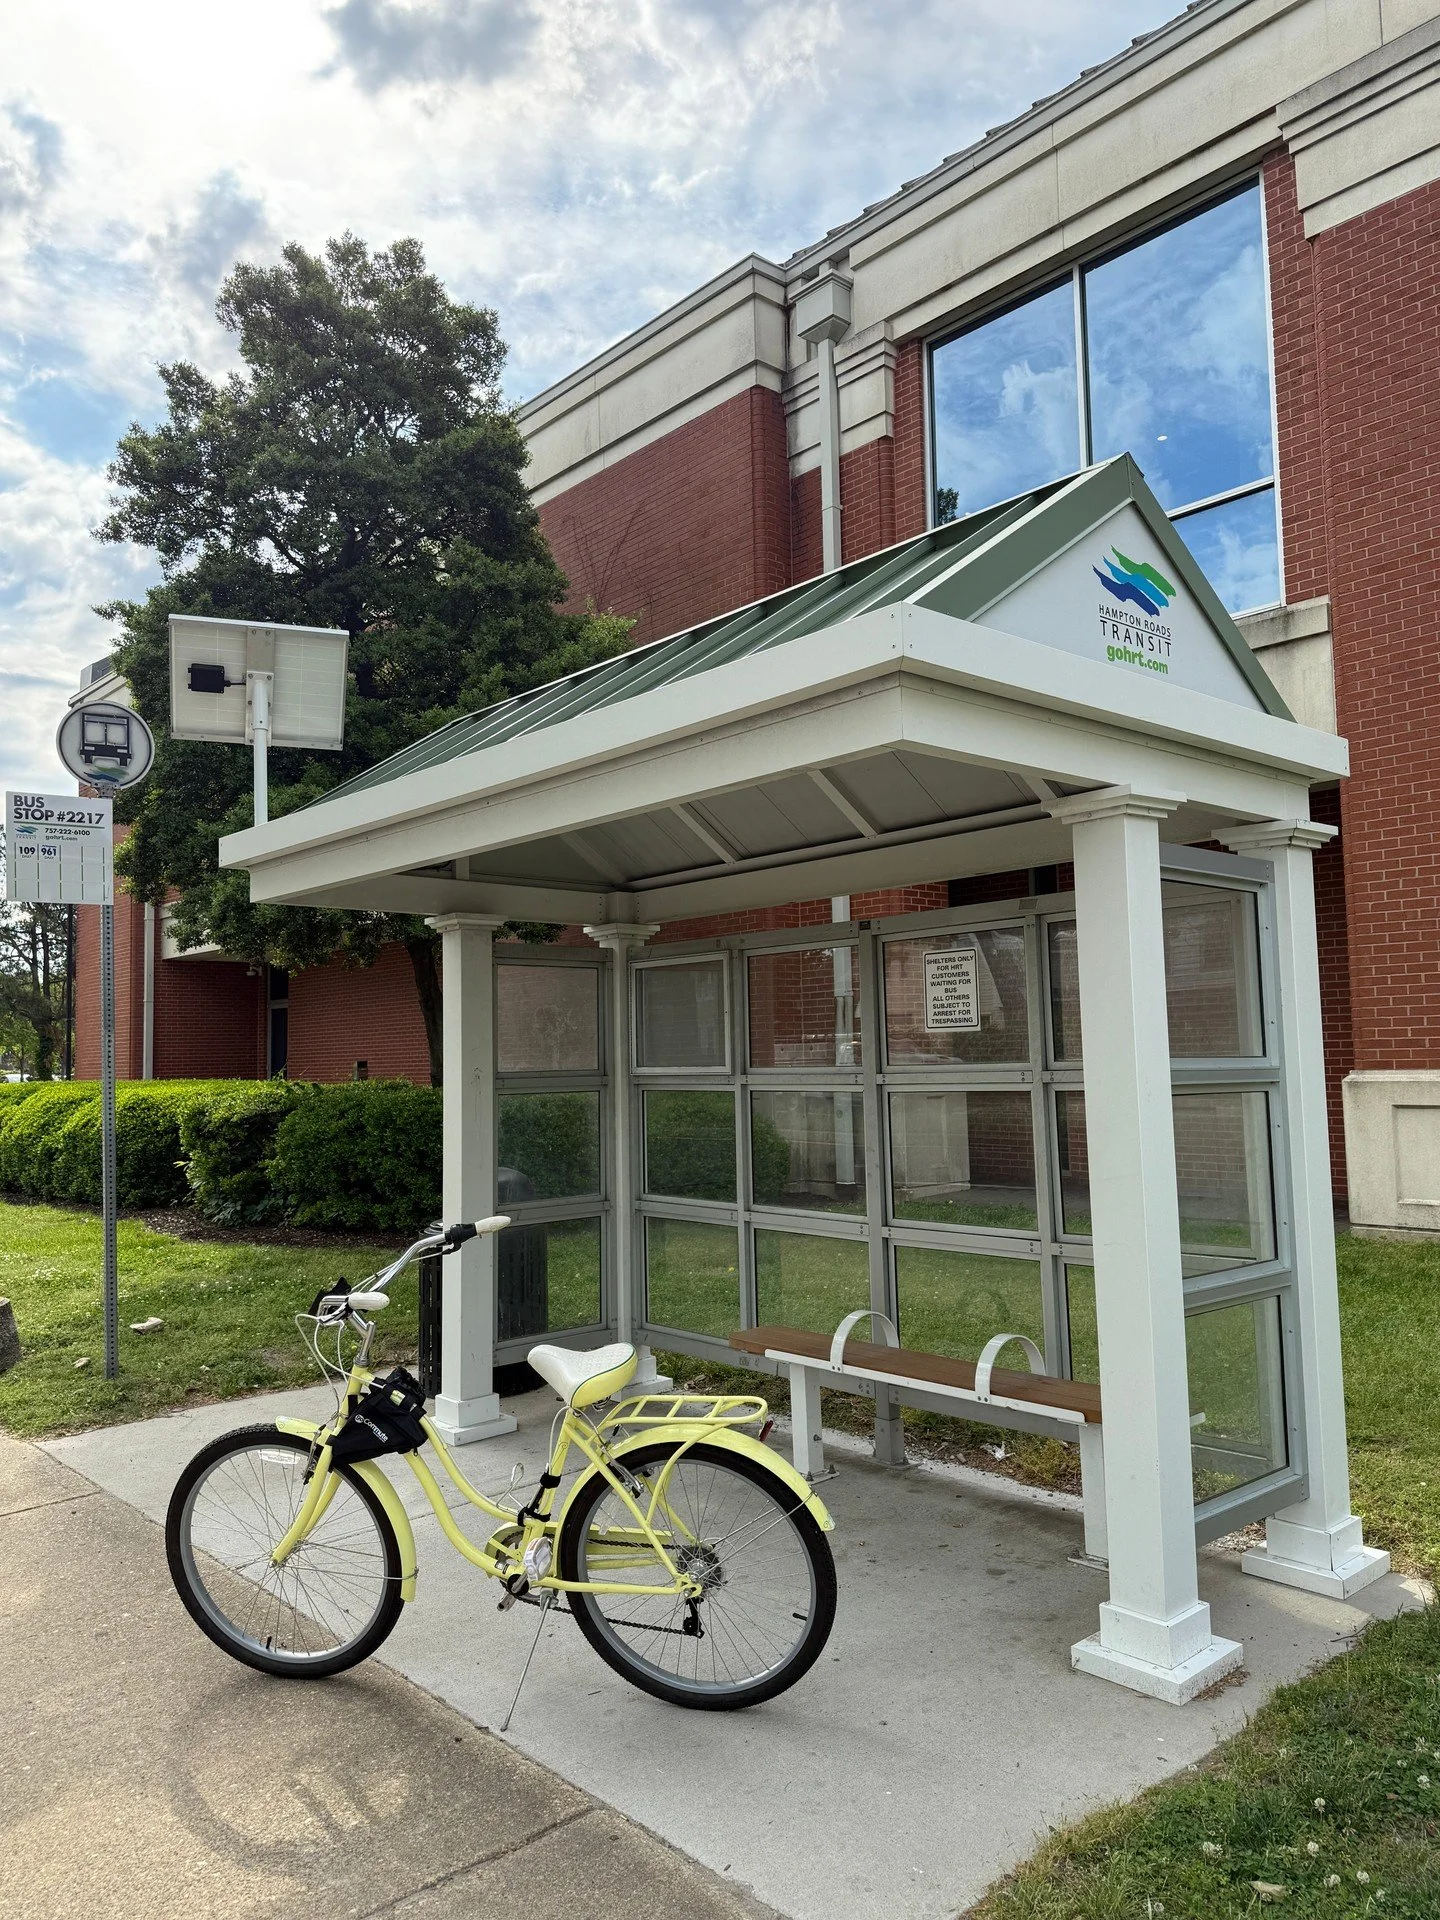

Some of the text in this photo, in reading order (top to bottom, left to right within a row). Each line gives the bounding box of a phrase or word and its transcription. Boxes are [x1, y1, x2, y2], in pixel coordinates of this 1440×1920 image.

[1099, 604, 1171, 637] HAMPTON ROADS
[1100, 619, 1171, 656] TRANSIT
[1106, 645, 1168, 674] gohrt.com
[13, 795, 44, 808] BUS
[13, 808, 104, 824] STOP #2217
[19, 846, 36, 854] 109
[41, 847, 57, 856] 961
[926, 957, 957, 965] SHELTERS
[931, 971, 970, 979] CUSTOMERS
[364, 1418, 388, 1441] Commute
